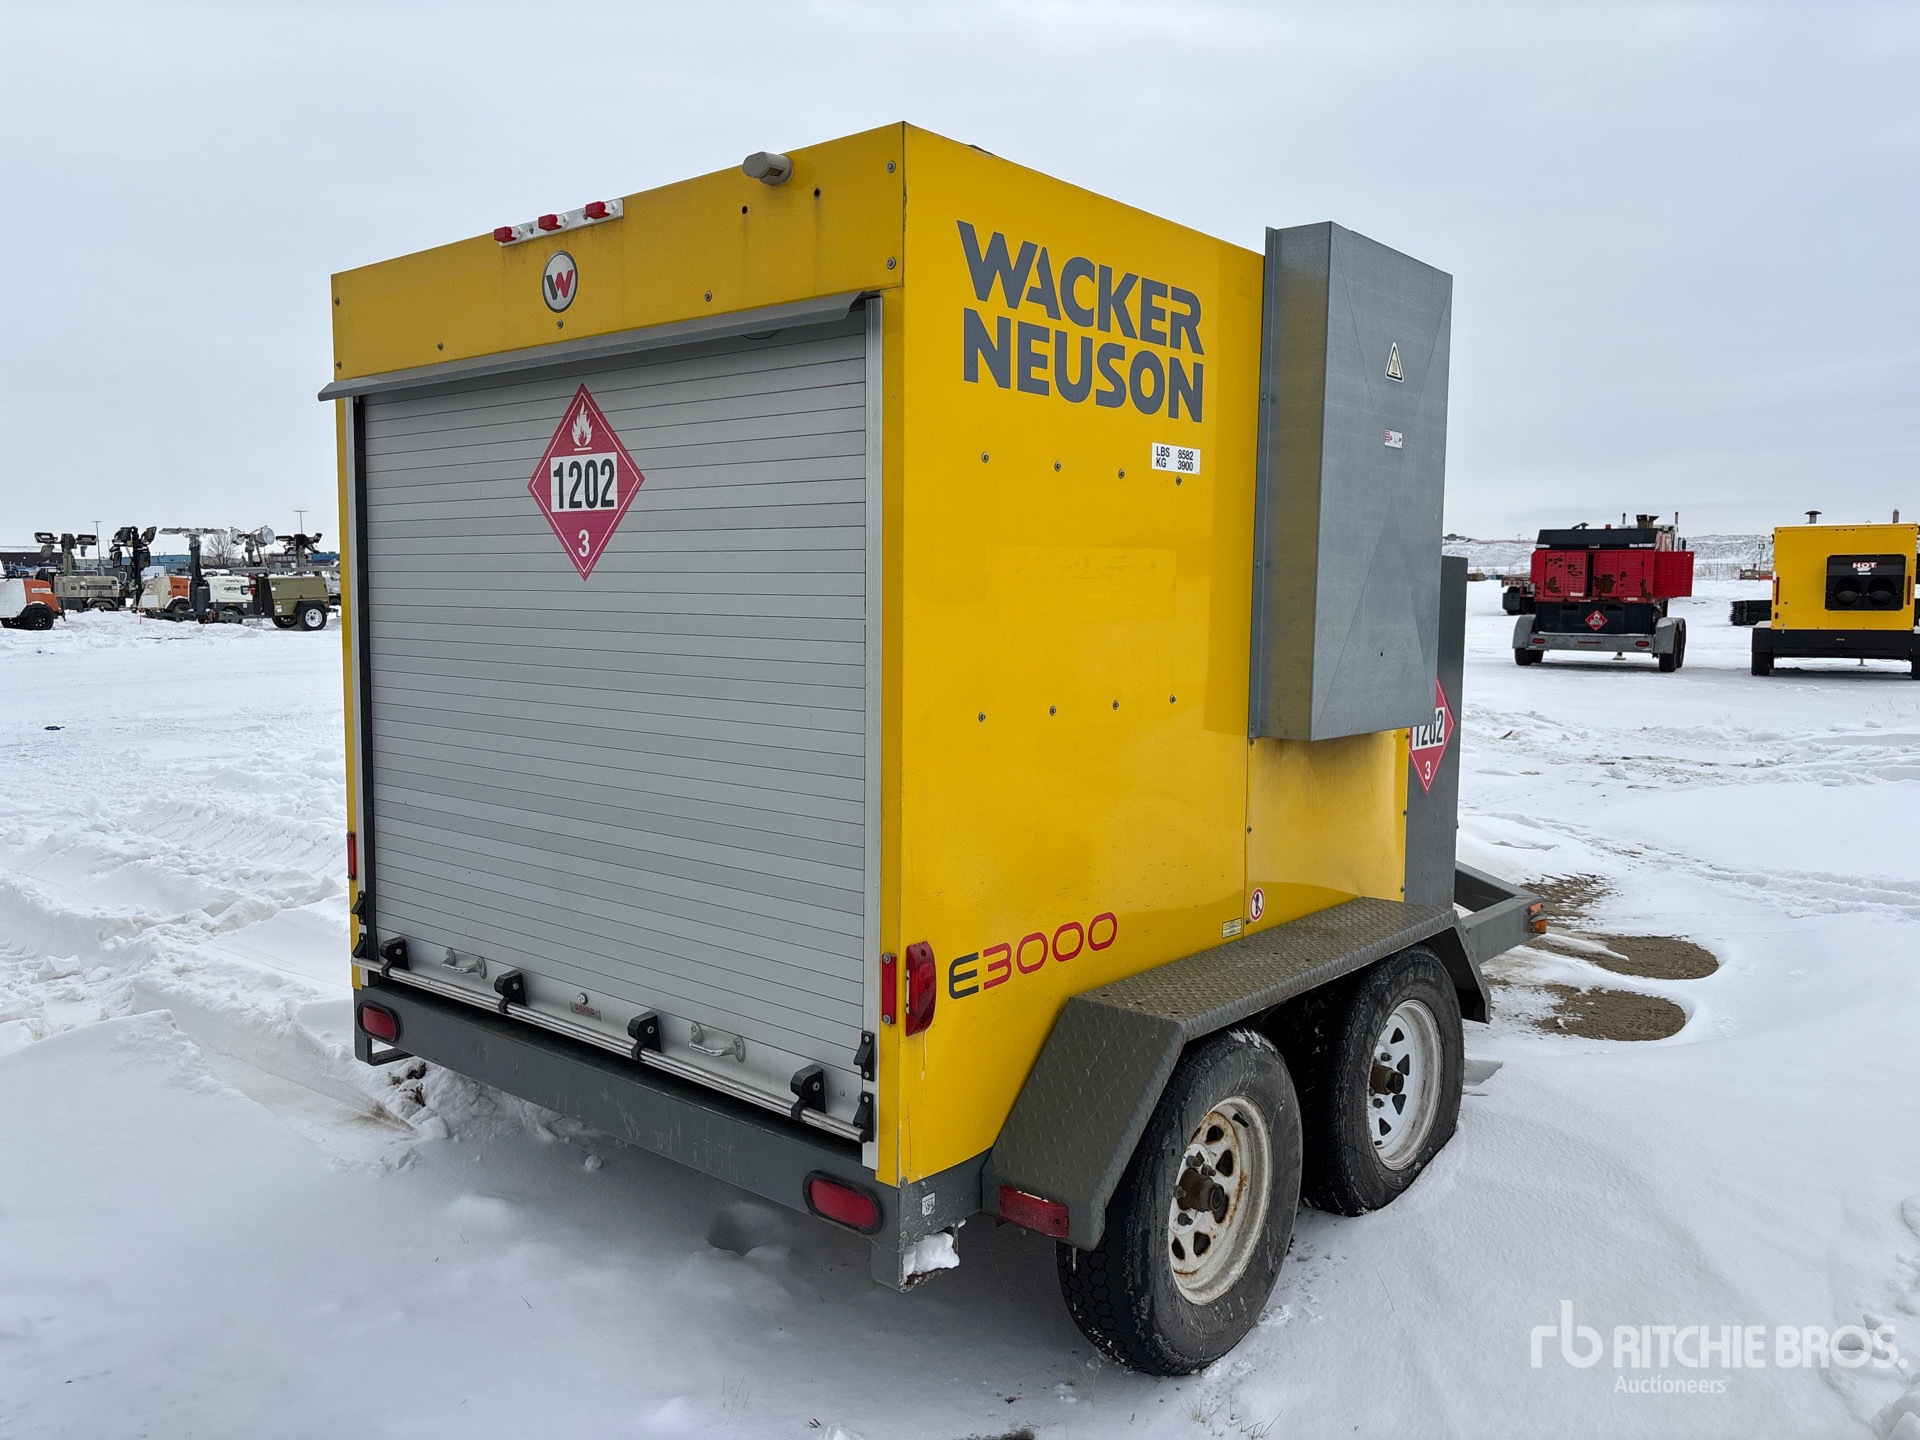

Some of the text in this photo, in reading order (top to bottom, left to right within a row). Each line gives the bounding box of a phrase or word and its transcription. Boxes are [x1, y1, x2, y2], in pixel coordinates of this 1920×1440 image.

[545, 269, 574, 301] W
[957, 220, 1204, 356] WACKER
[963, 307, 1204, 423] NEUSON
[1156, 446, 1194, 461] LBS 8582
[1156, 457, 1194, 471] KG 3900
[553, 458, 615, 510] 1202
[578, 529, 590, 557] 3
[1424, 760, 1431, 780] 3
[949, 911, 1118, 1000] E3000
